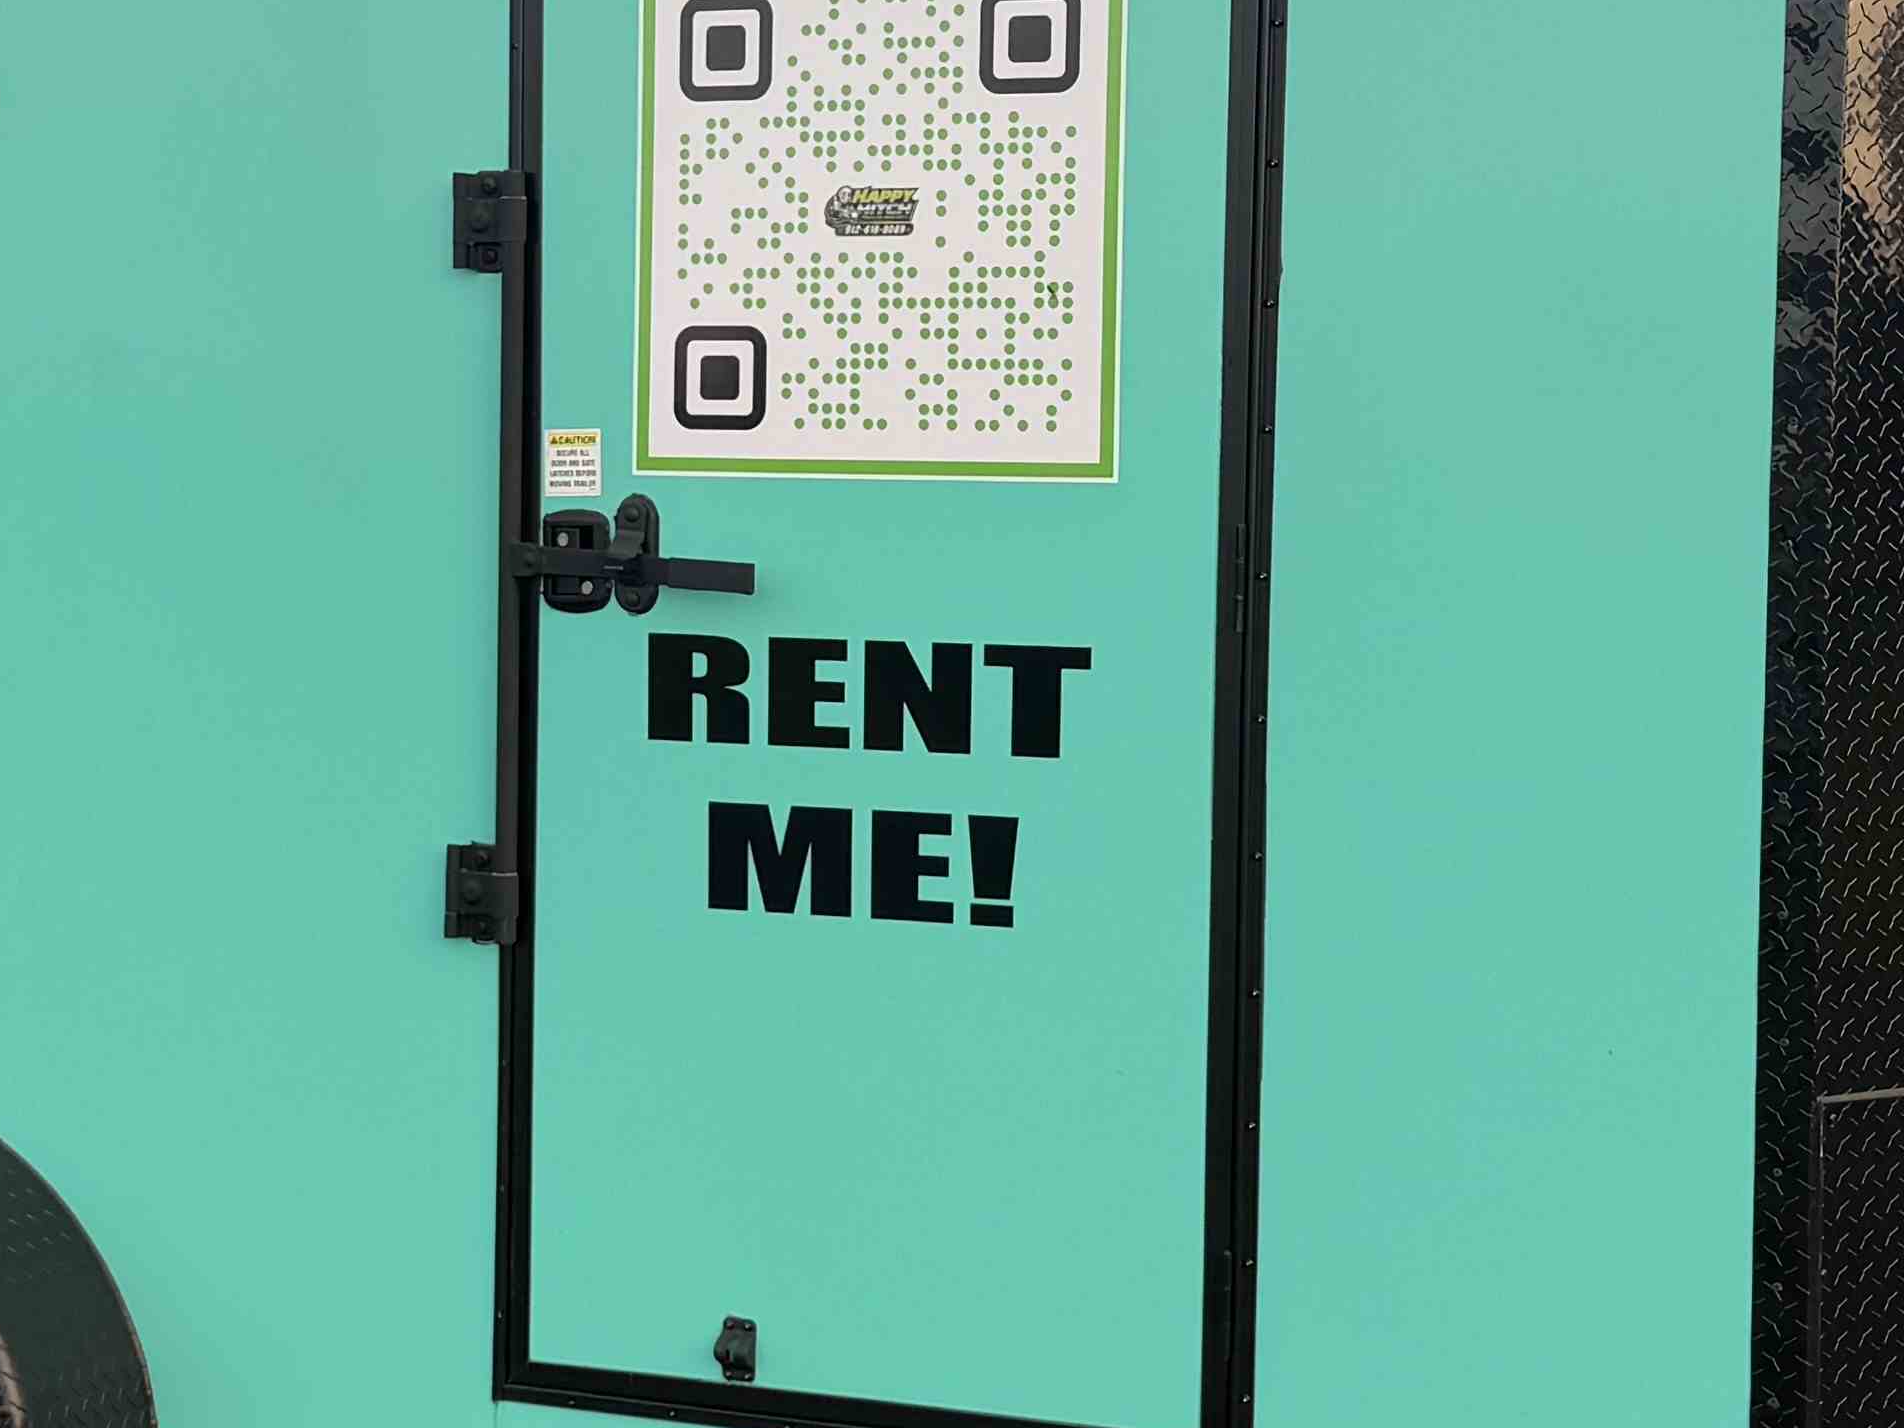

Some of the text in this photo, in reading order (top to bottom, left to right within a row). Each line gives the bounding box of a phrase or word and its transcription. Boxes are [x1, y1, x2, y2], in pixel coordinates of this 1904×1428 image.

[852, 188, 914, 204] HAPPY
[559, 435, 597, 444] CAUTION
[647, 631, 1092, 759] RENT
[708, 801, 1020, 929] ME!
